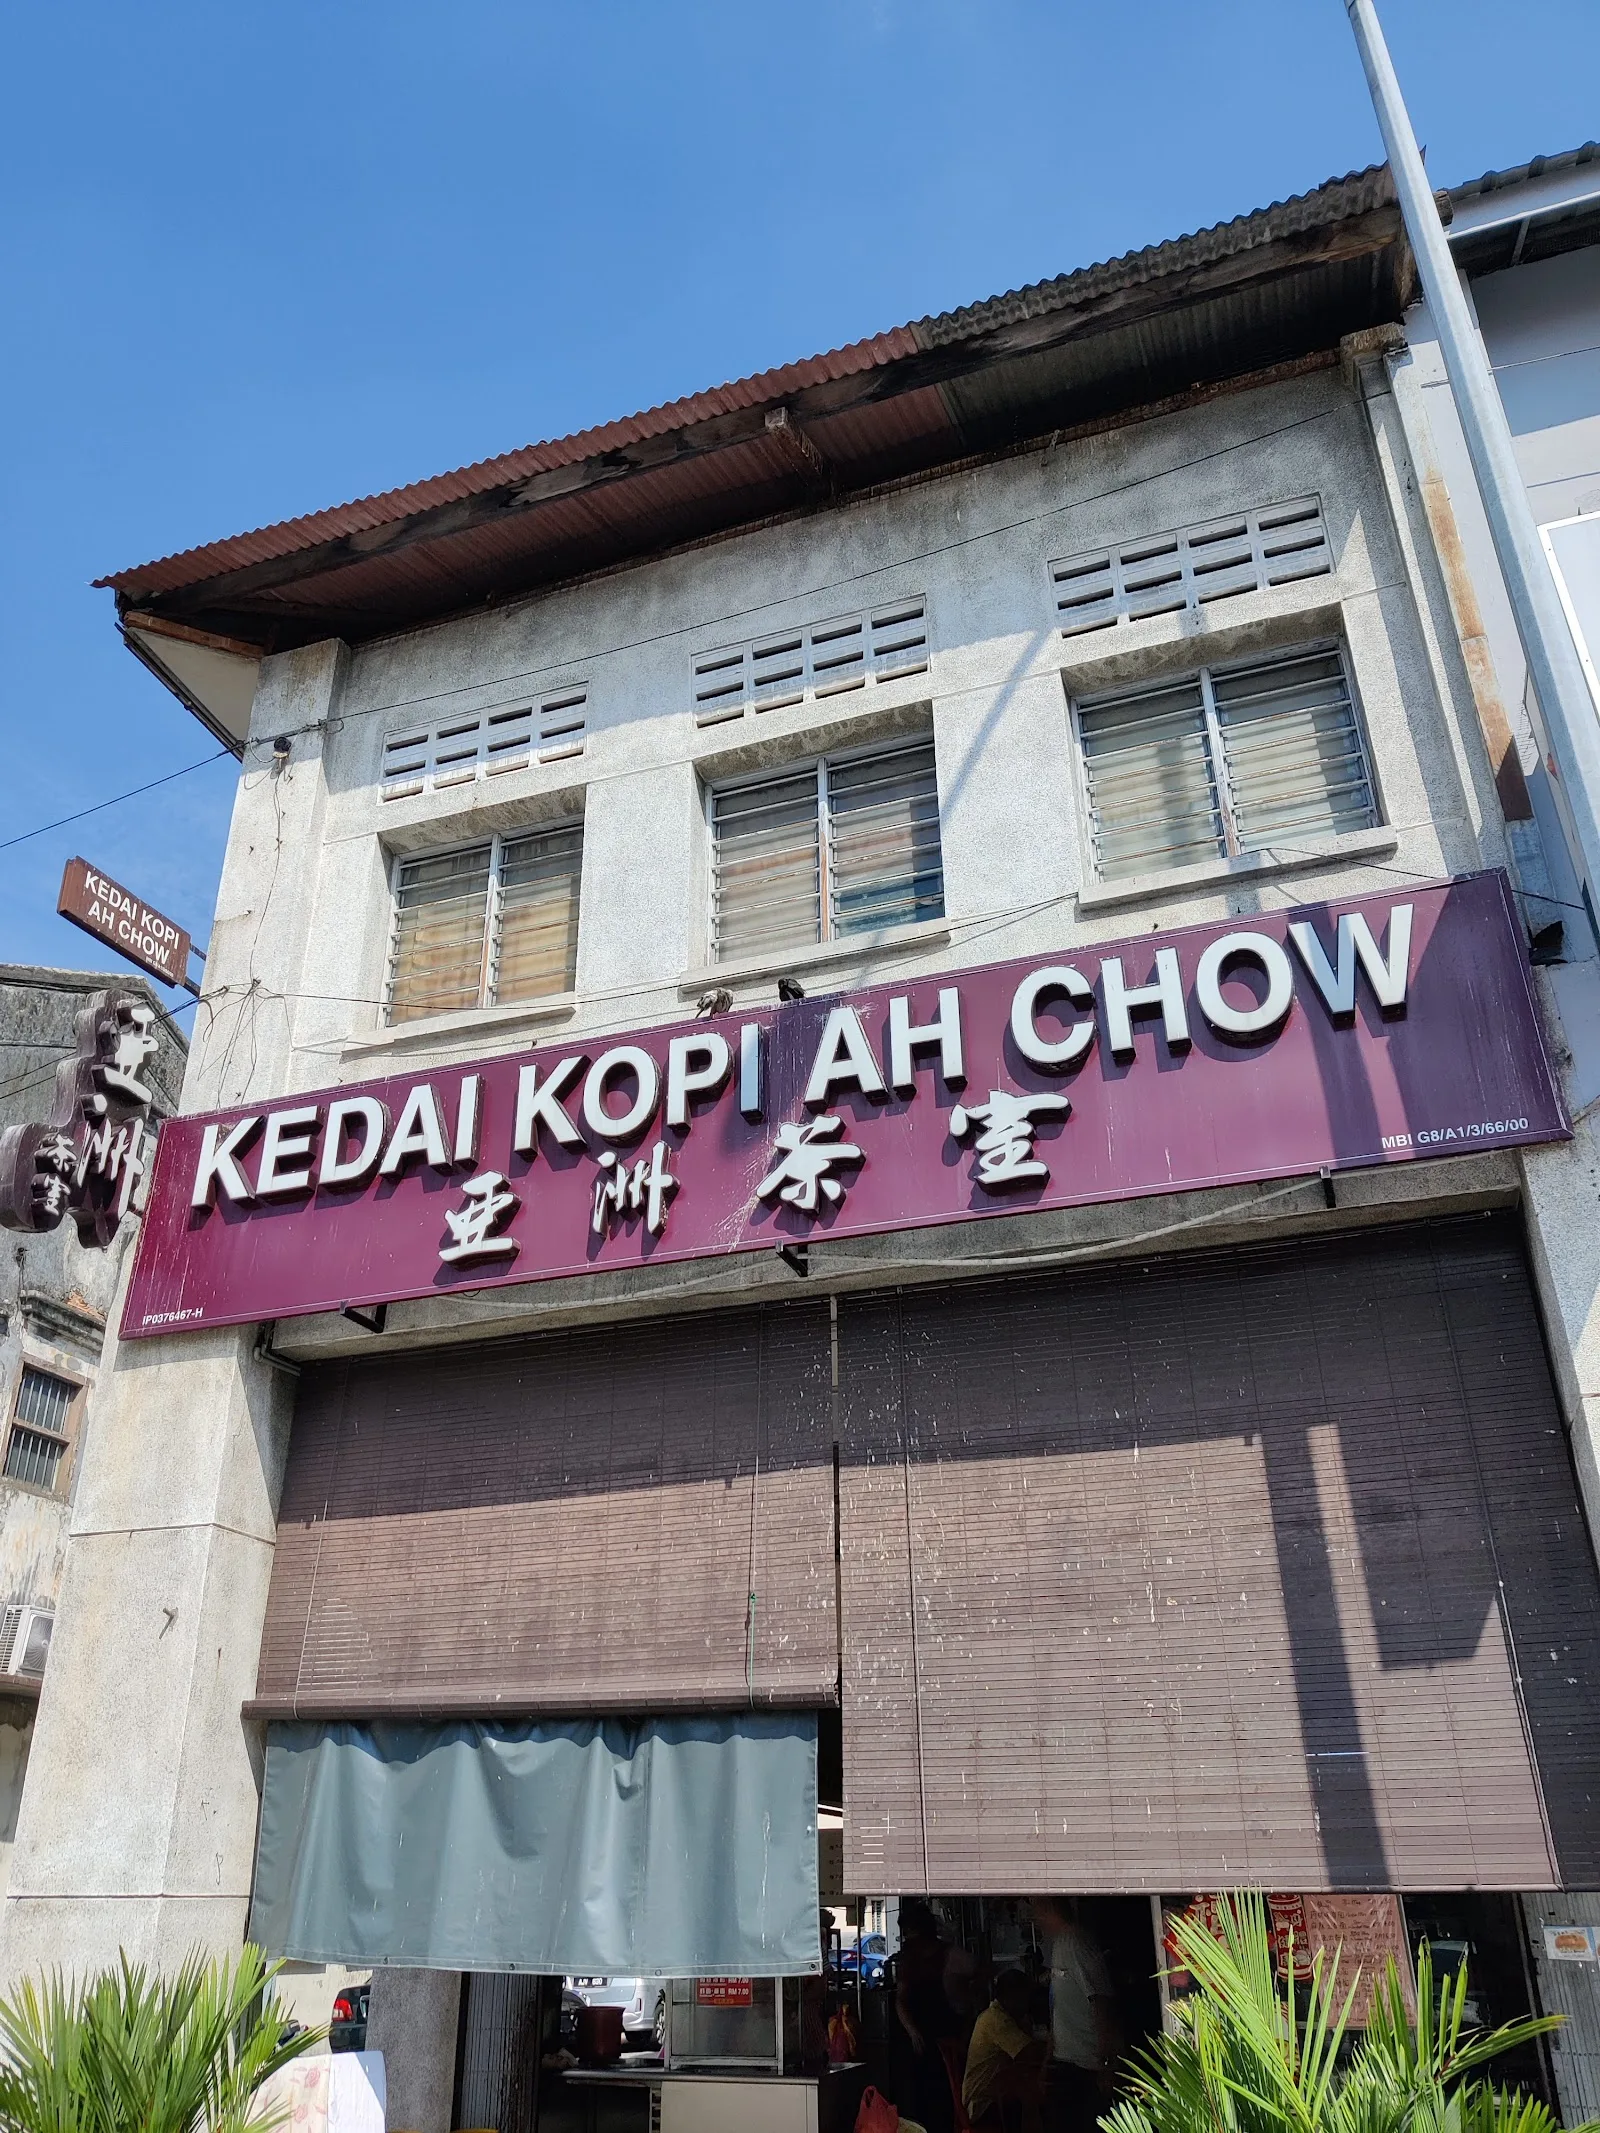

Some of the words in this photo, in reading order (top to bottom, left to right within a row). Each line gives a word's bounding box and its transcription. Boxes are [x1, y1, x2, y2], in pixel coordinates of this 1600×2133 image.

[84, 871, 138, 921] KEDAI
[140, 909, 180, 950] KOPI
[88, 900, 116, 930] AH
[118, 919, 171, 966] CHOW
[191, 1075, 478, 1206] KEDAI
[514, 1021, 759, 1151] KOPI
[804, 986, 963, 1102] AH
[1011, 903, 1414, 1063] CHOW
[1381, 1134, 1413, 1149] MBI
[1417, 1117, 1529, 1145] G8/A1/3/66/00
[142, 1307, 204, 1326] IP0376467-H
[727, 1988, 738, 1996] RM
[738, 1988, 750, 1996] 7.00
